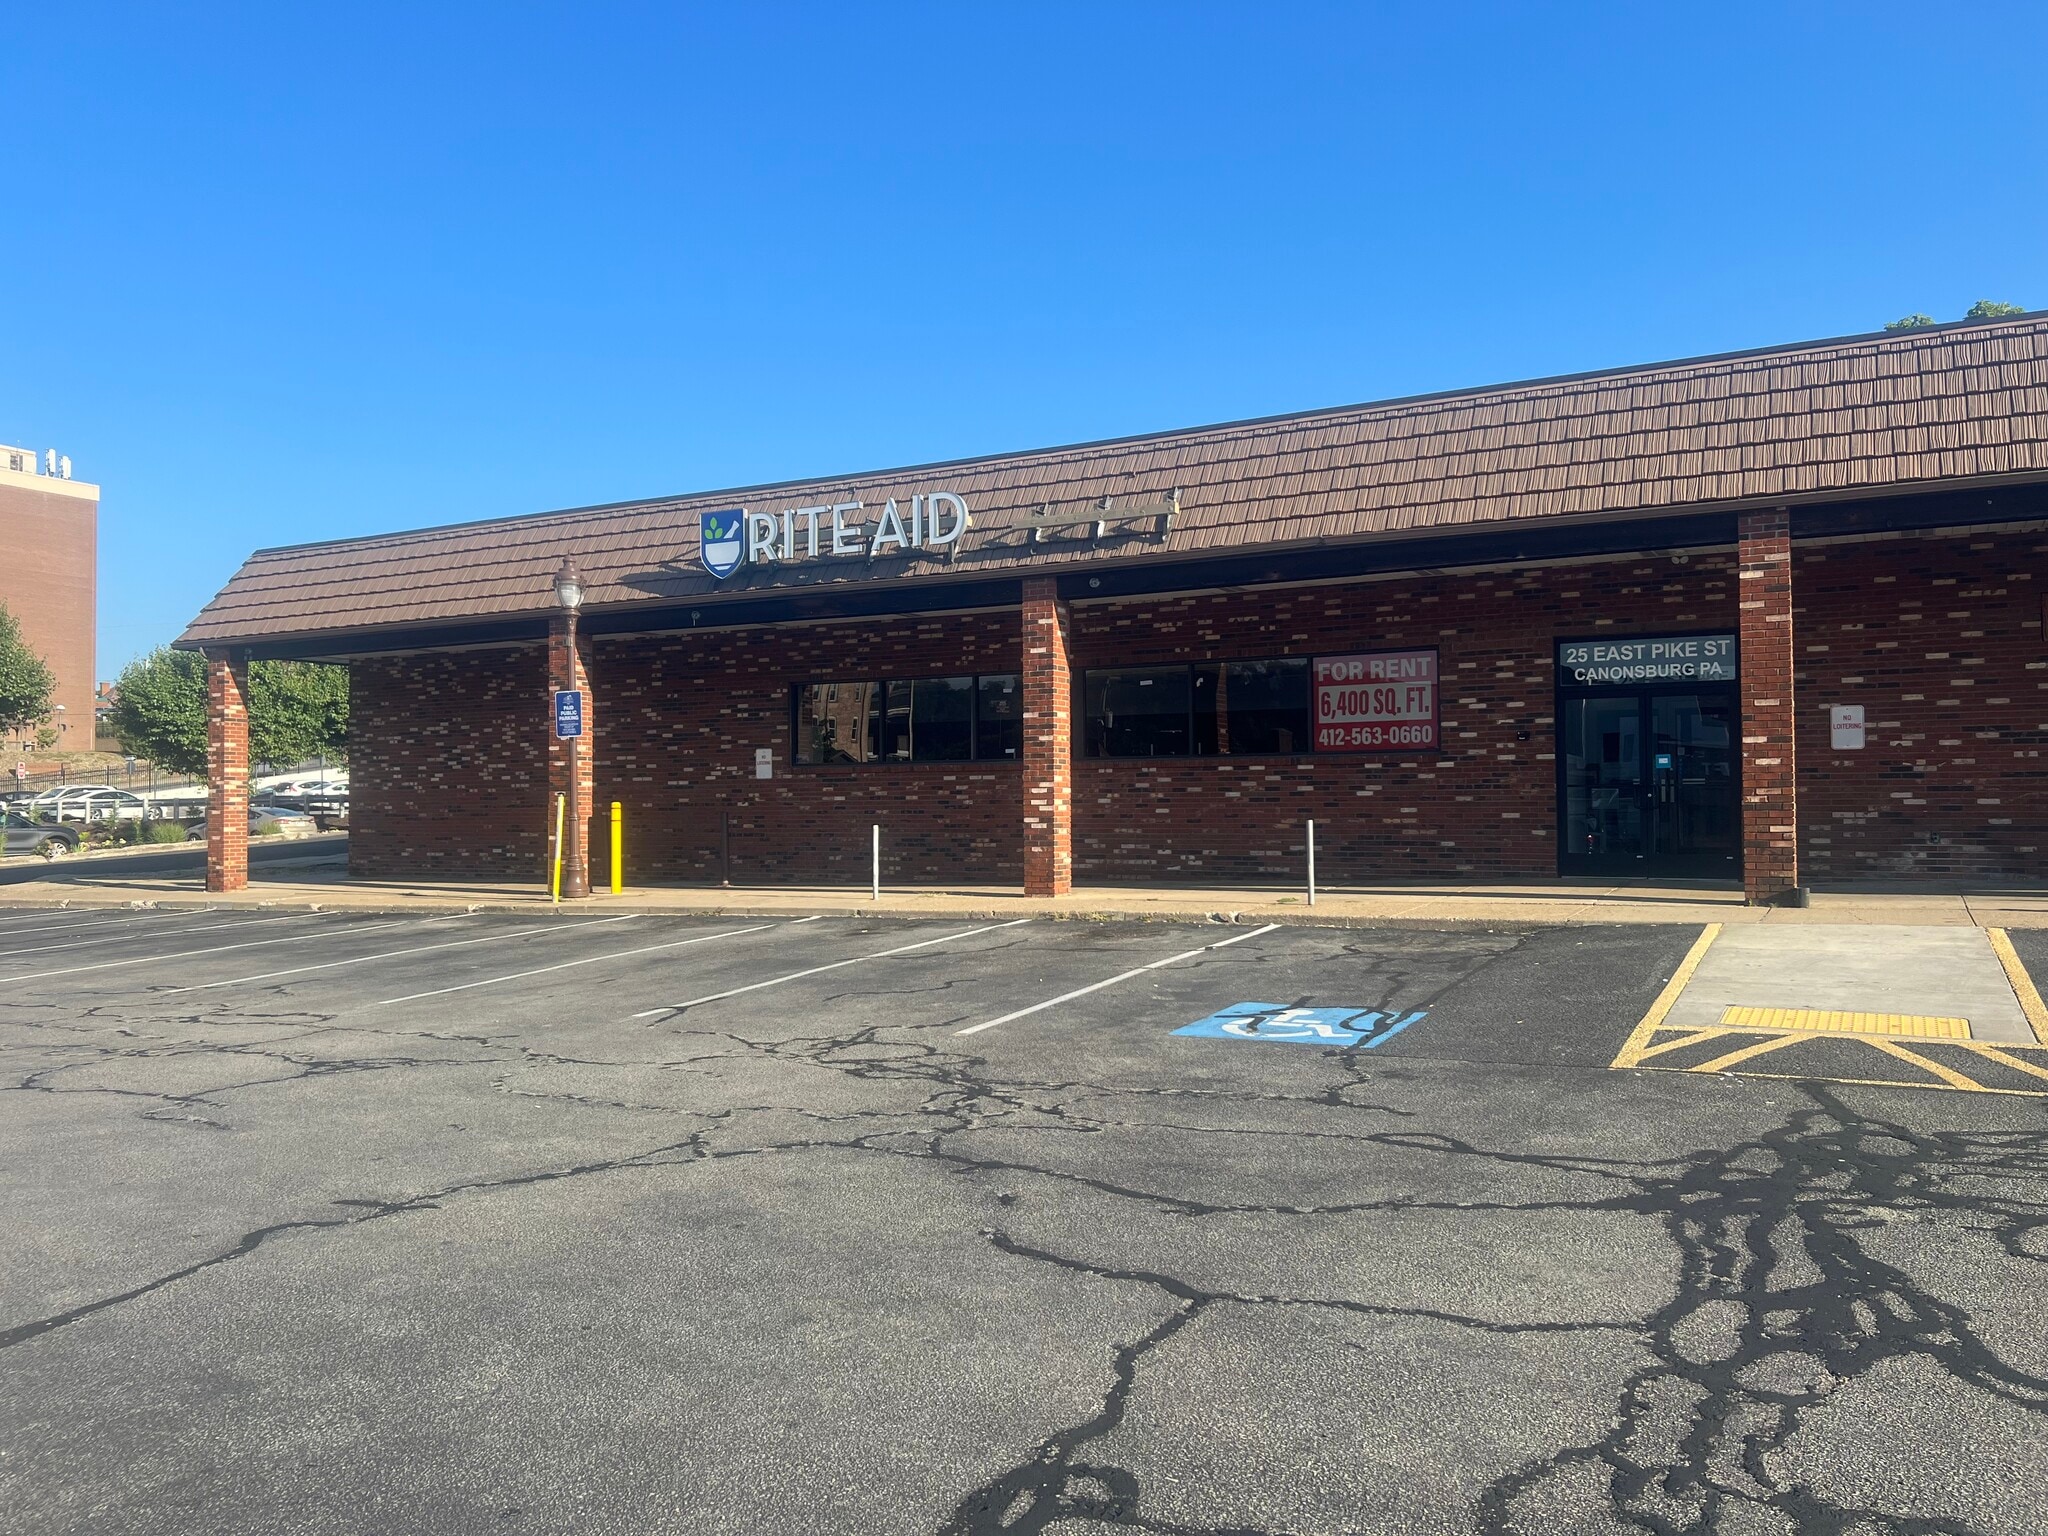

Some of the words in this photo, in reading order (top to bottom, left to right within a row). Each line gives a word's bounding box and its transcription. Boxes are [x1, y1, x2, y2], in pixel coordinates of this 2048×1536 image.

[749, 501, 864, 562] RITE
[871, 491, 970, 552] AID
[1566, 648, 1588, 663] 25
[1594, 644, 1646, 662] EAST
[1651, 641, 1698, 659] PIKE
[1704, 640, 1731, 656] ST
[1318, 661, 1364, 682] FOR
[1370, 657, 1432, 679] RENT
[1574, 663, 1695, 681] CANONSBURG
[1700, 661, 1723, 675] PA
[1320, 690, 1370, 720] 6,400
[1374, 687, 1402, 716] SQ.
[1406, 687, 1430, 713] FT.
[1319, 725, 1433, 746] 412-563-0660
